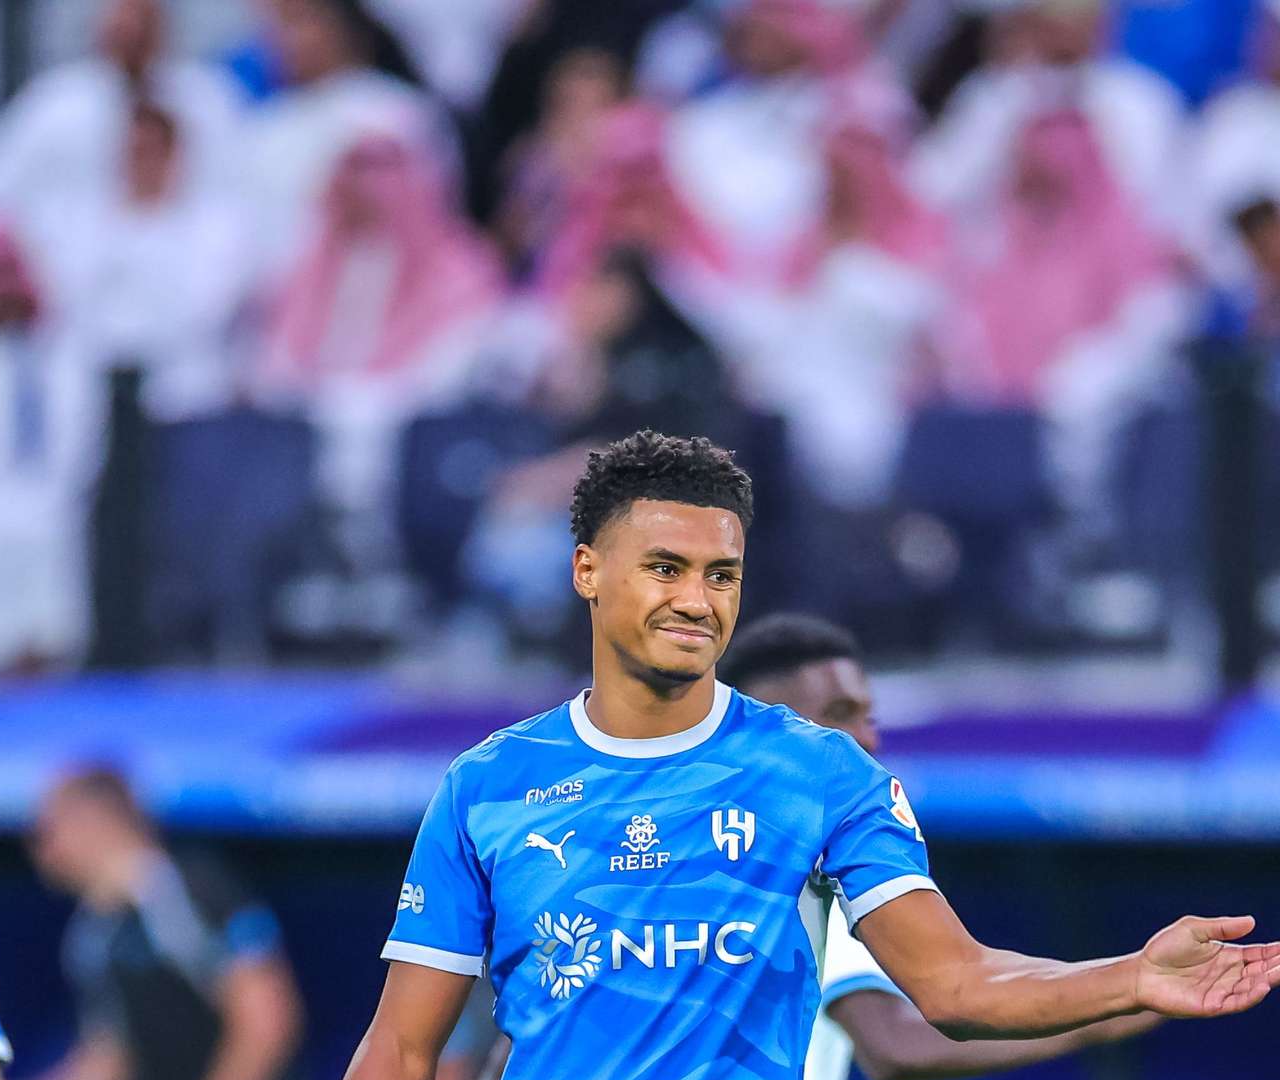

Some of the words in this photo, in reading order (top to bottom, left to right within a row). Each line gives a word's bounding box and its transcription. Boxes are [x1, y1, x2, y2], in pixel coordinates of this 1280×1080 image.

[525, 779, 584, 806] flynas
[609, 852, 671, 872] REEF
[611, 921, 756, 970] NHC
